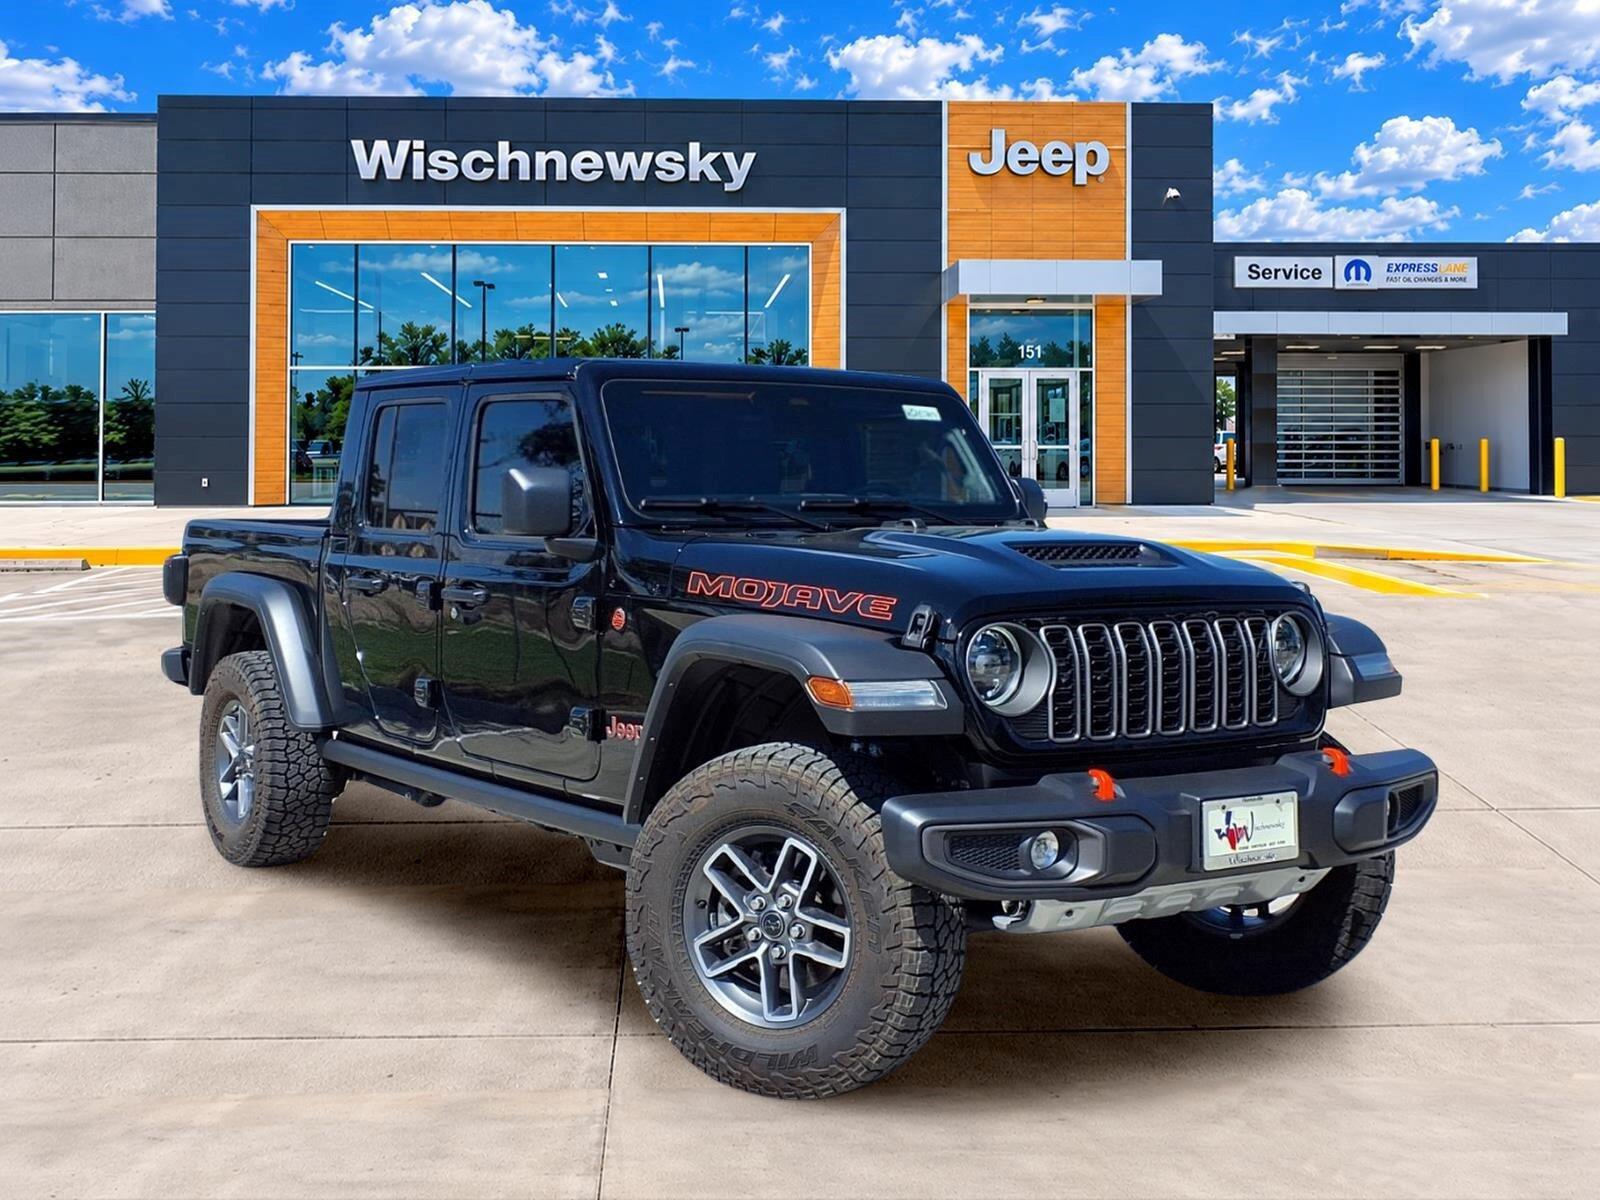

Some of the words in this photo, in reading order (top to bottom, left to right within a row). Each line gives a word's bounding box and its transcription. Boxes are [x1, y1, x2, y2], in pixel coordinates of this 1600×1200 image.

[350, 139, 757, 192] Wischnewsky
[968, 128, 1110, 185] Jeep
[1247, 263, 1323, 280] Service
[1018, 345, 1041, 359] 151
[687, 571, 897, 620] MOJAVE
